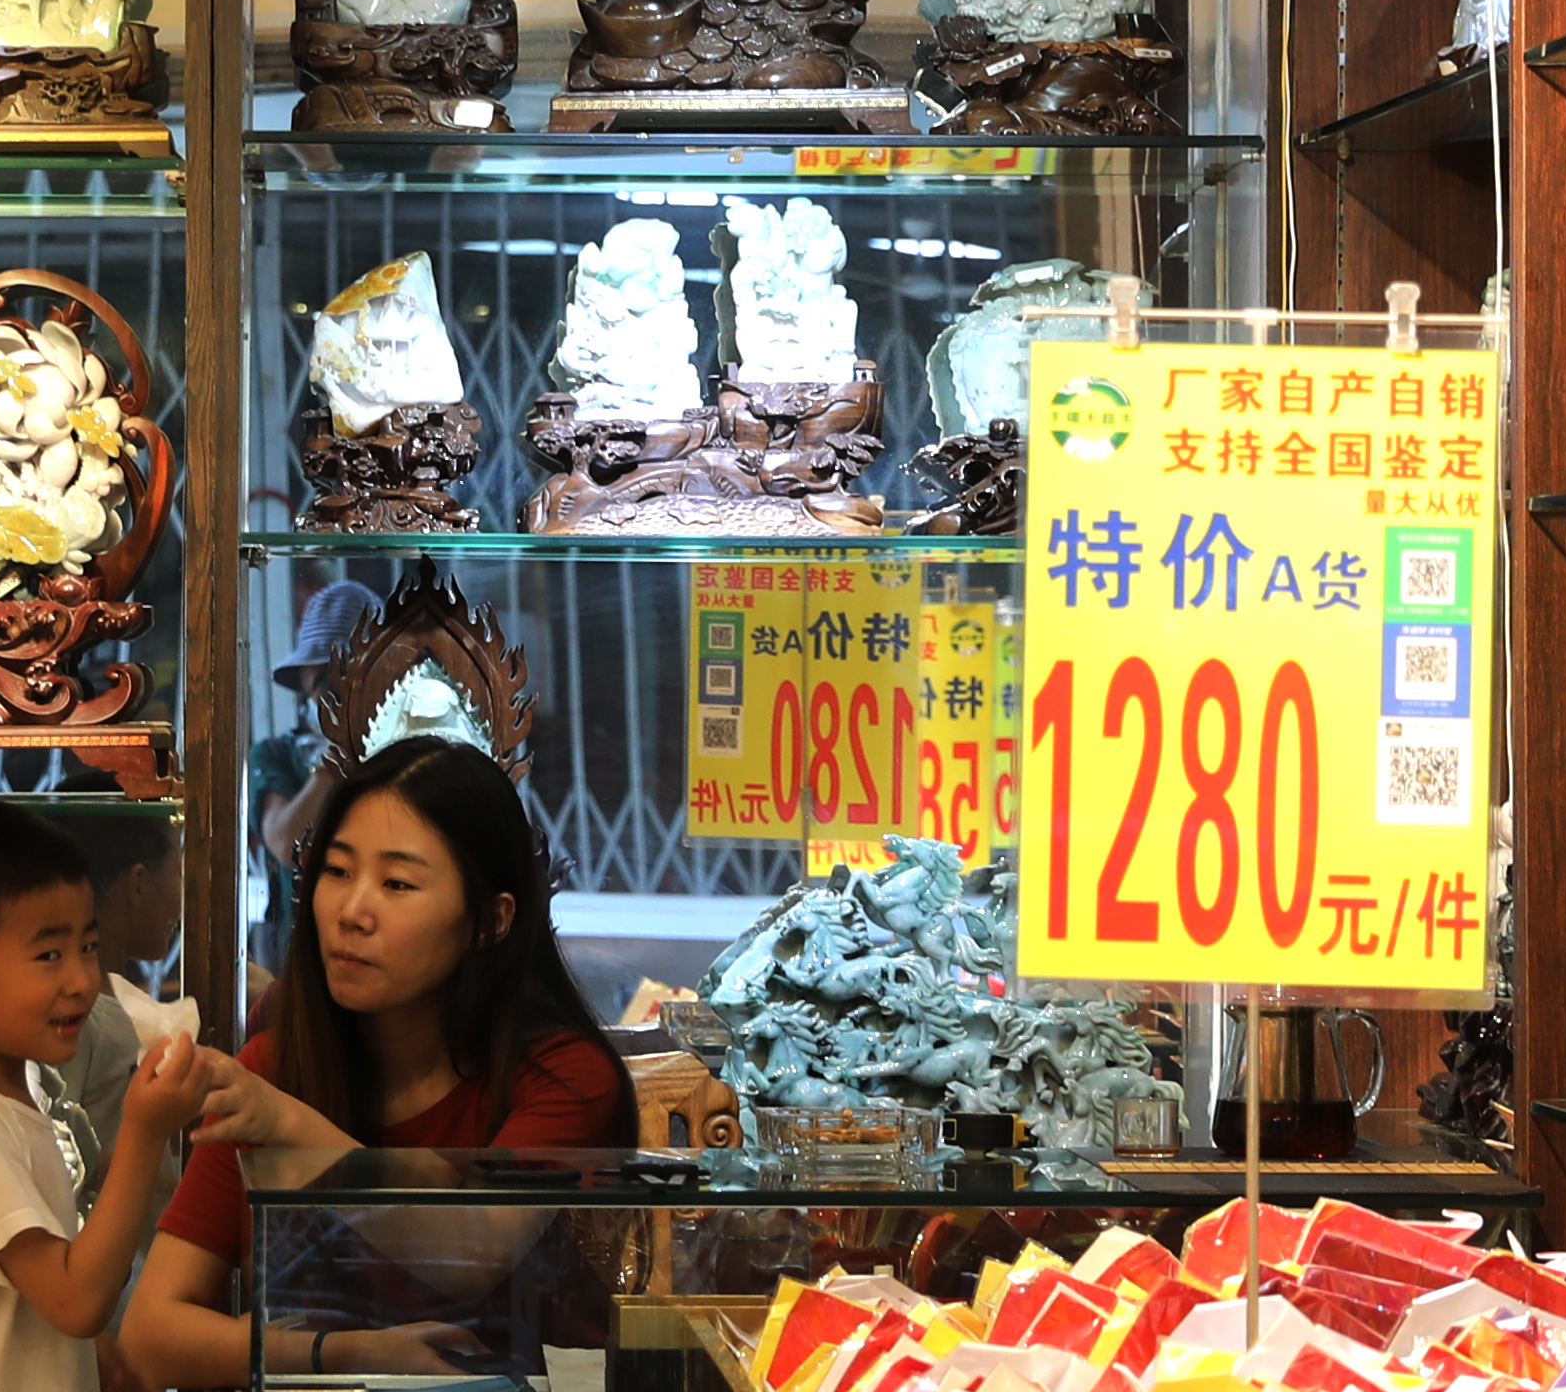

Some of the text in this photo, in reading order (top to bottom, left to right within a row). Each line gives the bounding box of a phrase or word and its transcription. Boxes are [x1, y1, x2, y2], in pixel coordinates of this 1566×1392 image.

[1162, 367, 1486, 420] 厂家自产自销
[1164, 427, 1484, 481] 支持全国鉴定
[1366, 489, 1482, 517] 量大从优
[1047, 508, 1368, 612] 特价A货
[1030, 655, 1481, 962] 1280元/件
